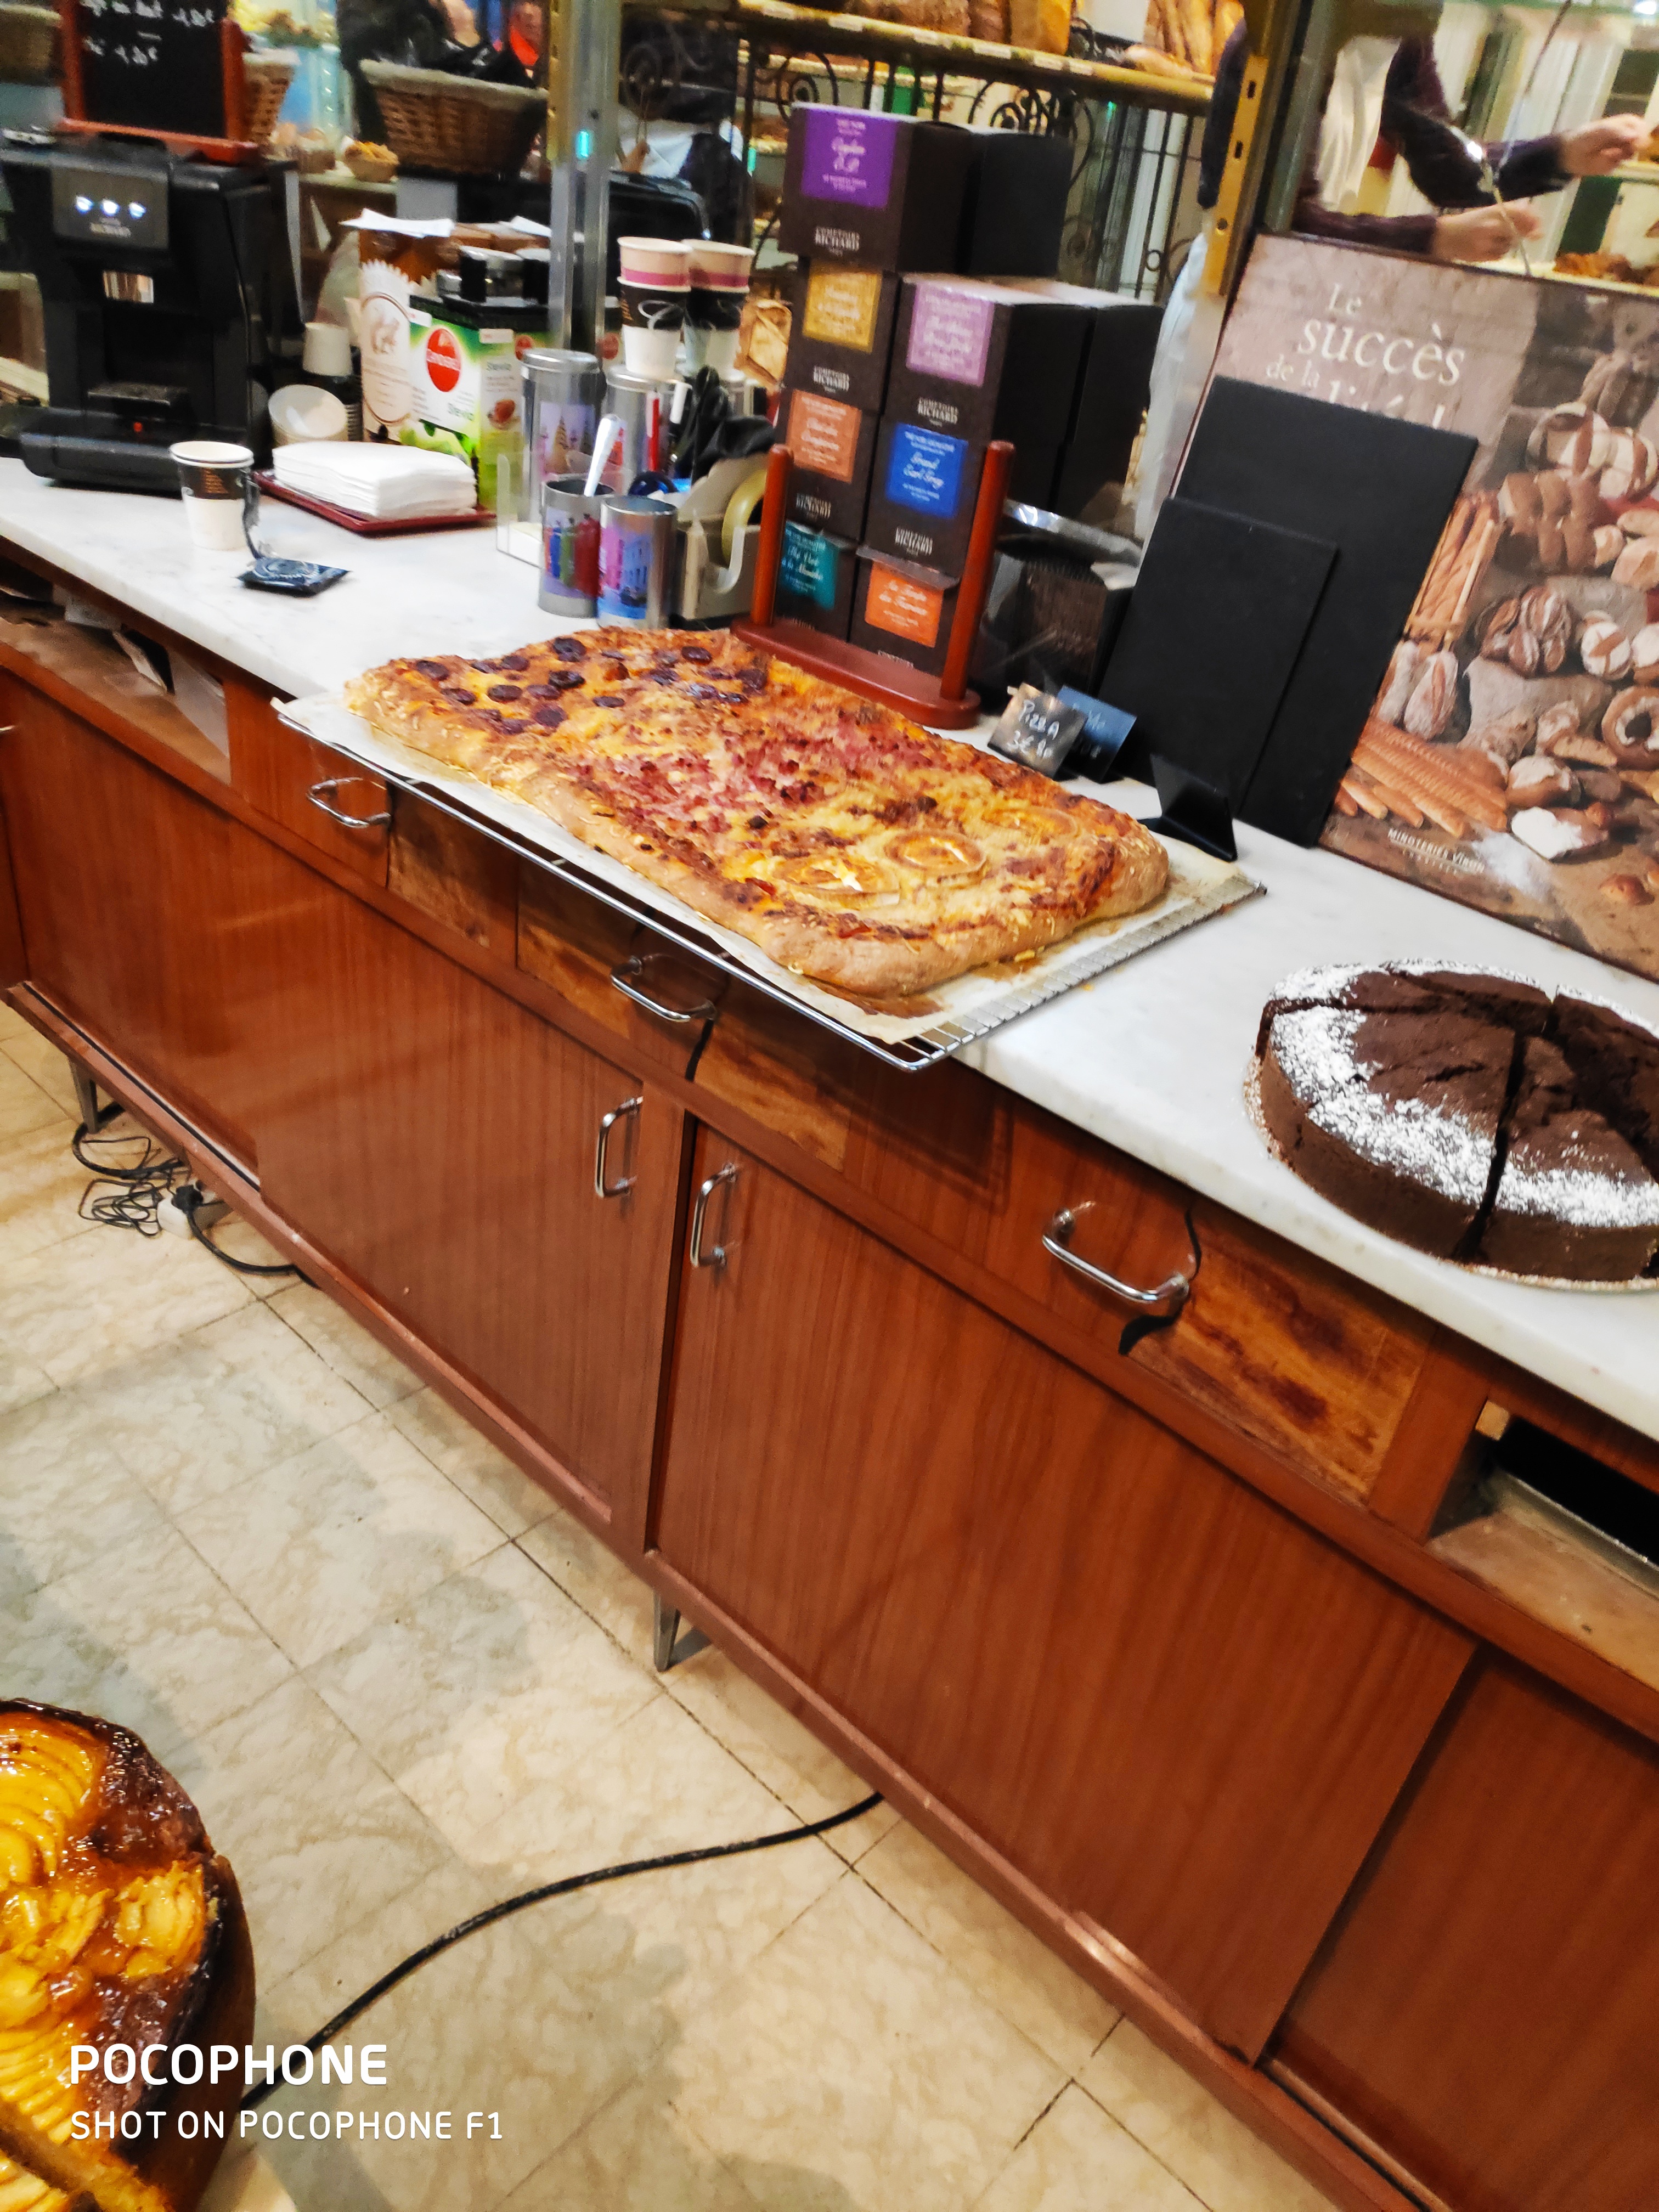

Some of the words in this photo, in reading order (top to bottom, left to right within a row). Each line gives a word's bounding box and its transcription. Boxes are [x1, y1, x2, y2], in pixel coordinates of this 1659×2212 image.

[1328, 282, 1362, 315] Le
[1266, 353, 1294, 381] de
[1297, 318, 1466, 386] succès
